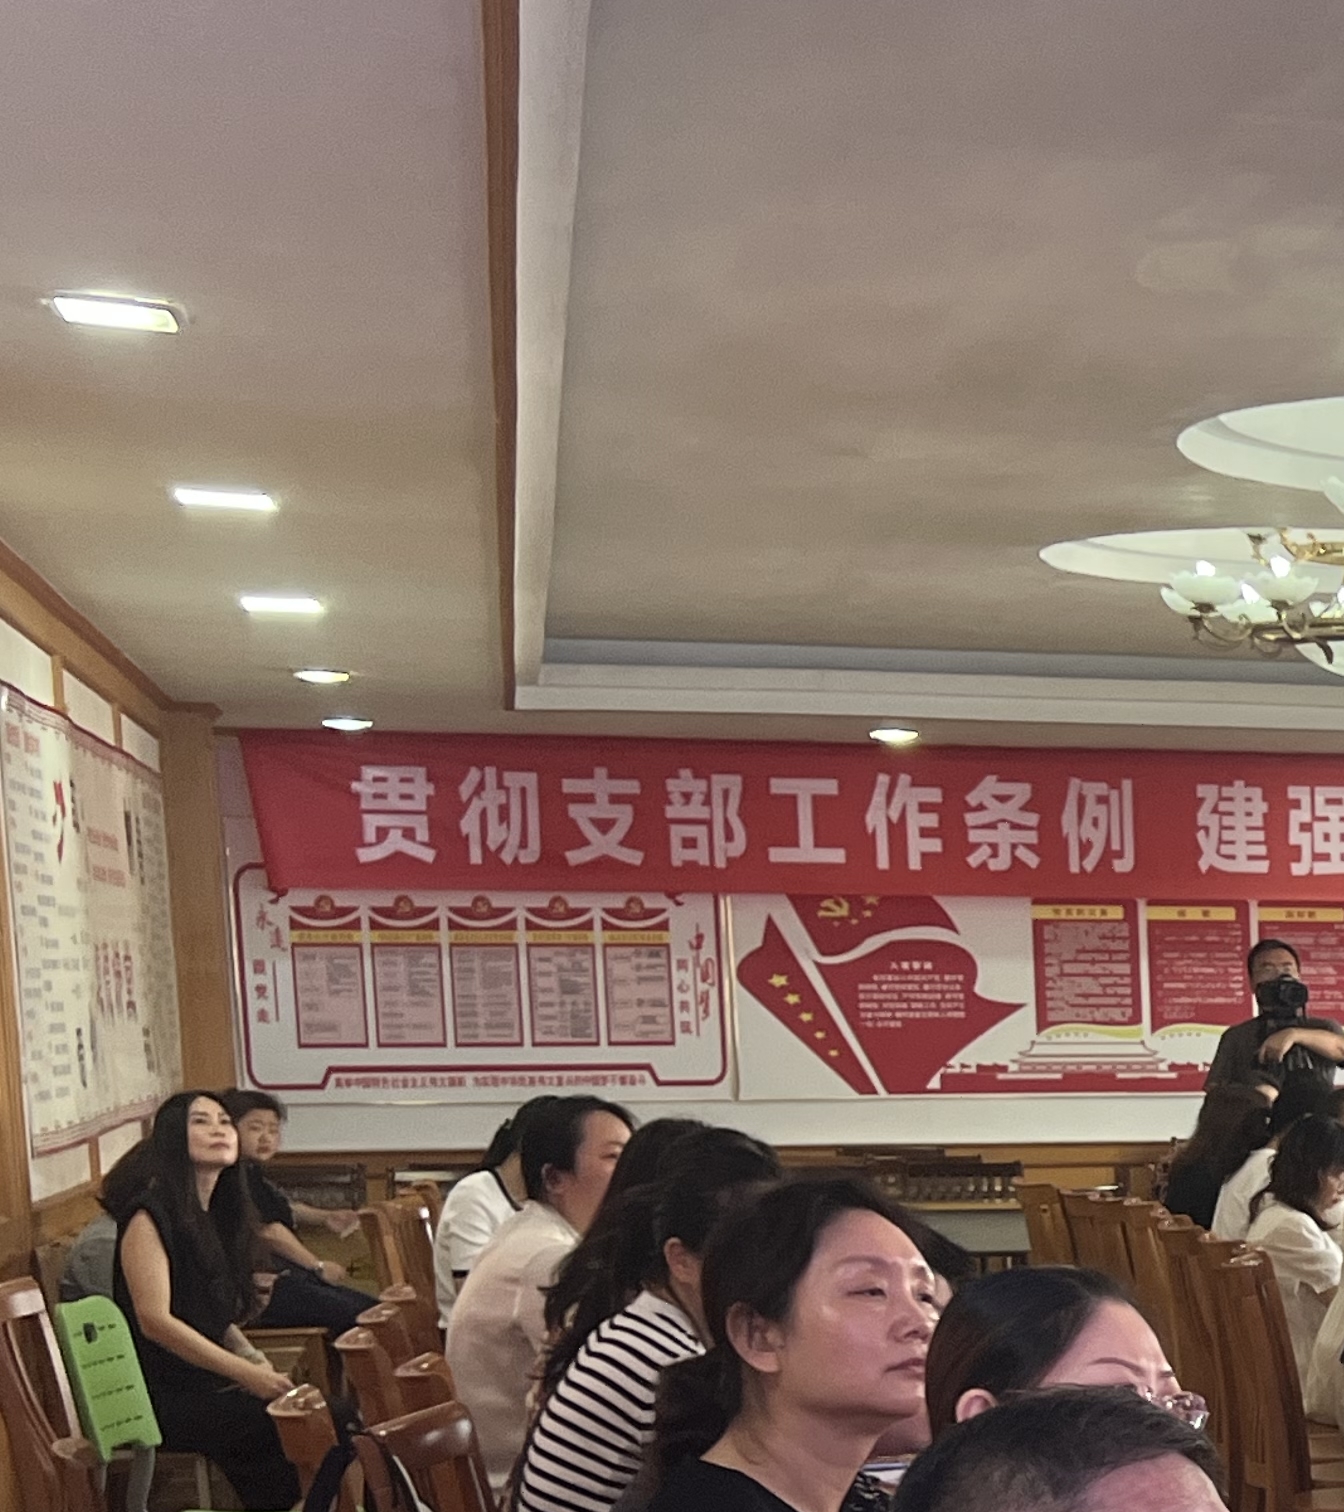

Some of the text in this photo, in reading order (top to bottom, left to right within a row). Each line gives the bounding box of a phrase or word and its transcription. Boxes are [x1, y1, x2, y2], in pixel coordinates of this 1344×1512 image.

[351, 765, 1135, 874] 贯彻支部工作条例
